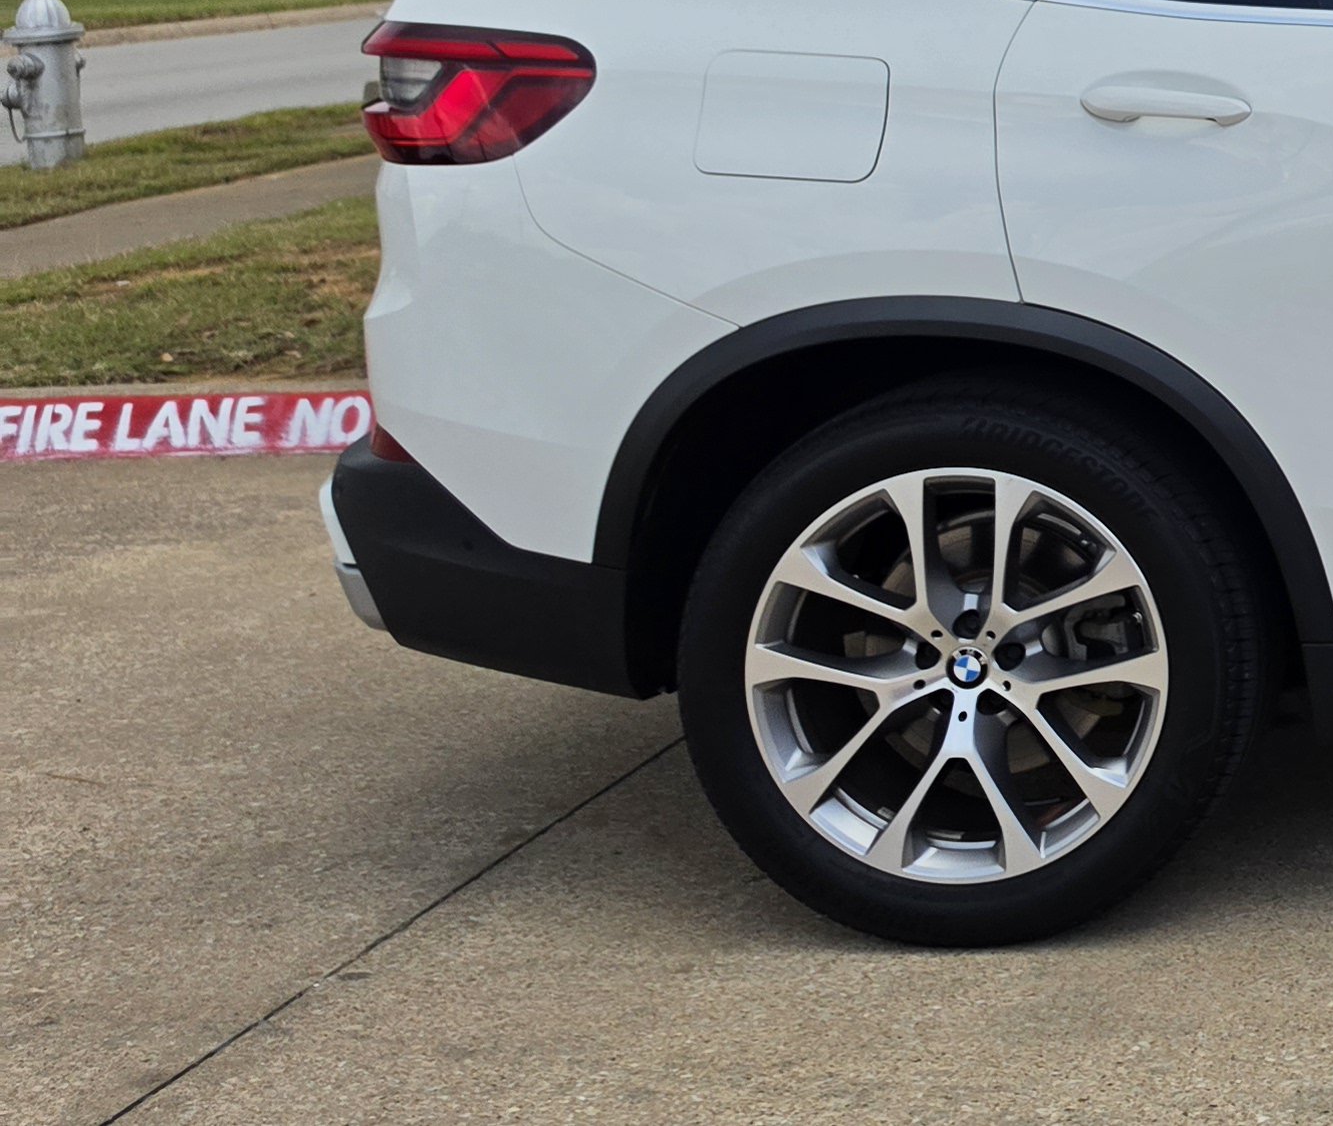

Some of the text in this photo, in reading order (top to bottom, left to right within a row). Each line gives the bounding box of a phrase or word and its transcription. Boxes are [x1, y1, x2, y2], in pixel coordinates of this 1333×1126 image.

[0, 395, 371, 454] FIRE LANE NO
